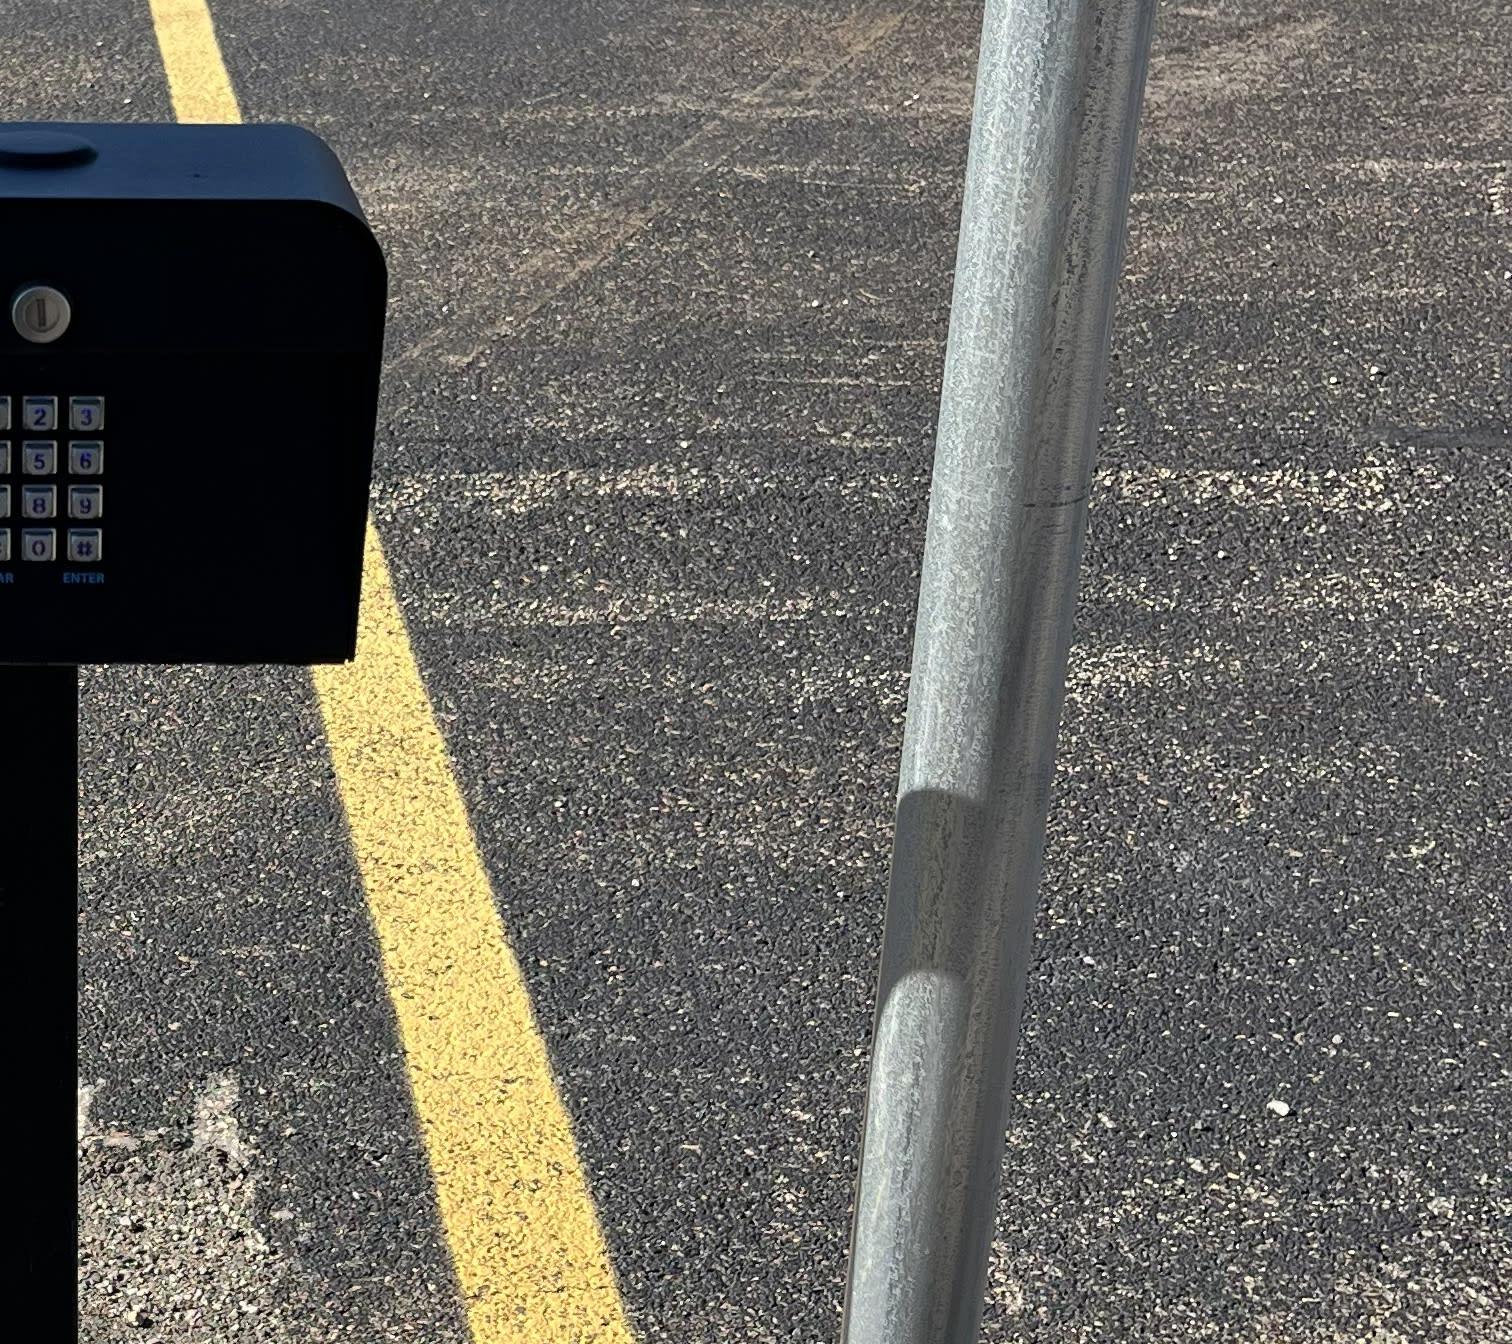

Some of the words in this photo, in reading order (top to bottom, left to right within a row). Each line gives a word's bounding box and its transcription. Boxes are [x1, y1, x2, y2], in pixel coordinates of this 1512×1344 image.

[33, 408, 47, 426] 2
[80, 408, 93, 426] 3
[33, 453, 46, 470] 5
[79, 452, 92, 470] 6
[32, 497, 46, 514] 8
[79, 497, 92, 514] 9
[32, 540, 46, 556] 0
[63, 572, 105, 584] ENTER
